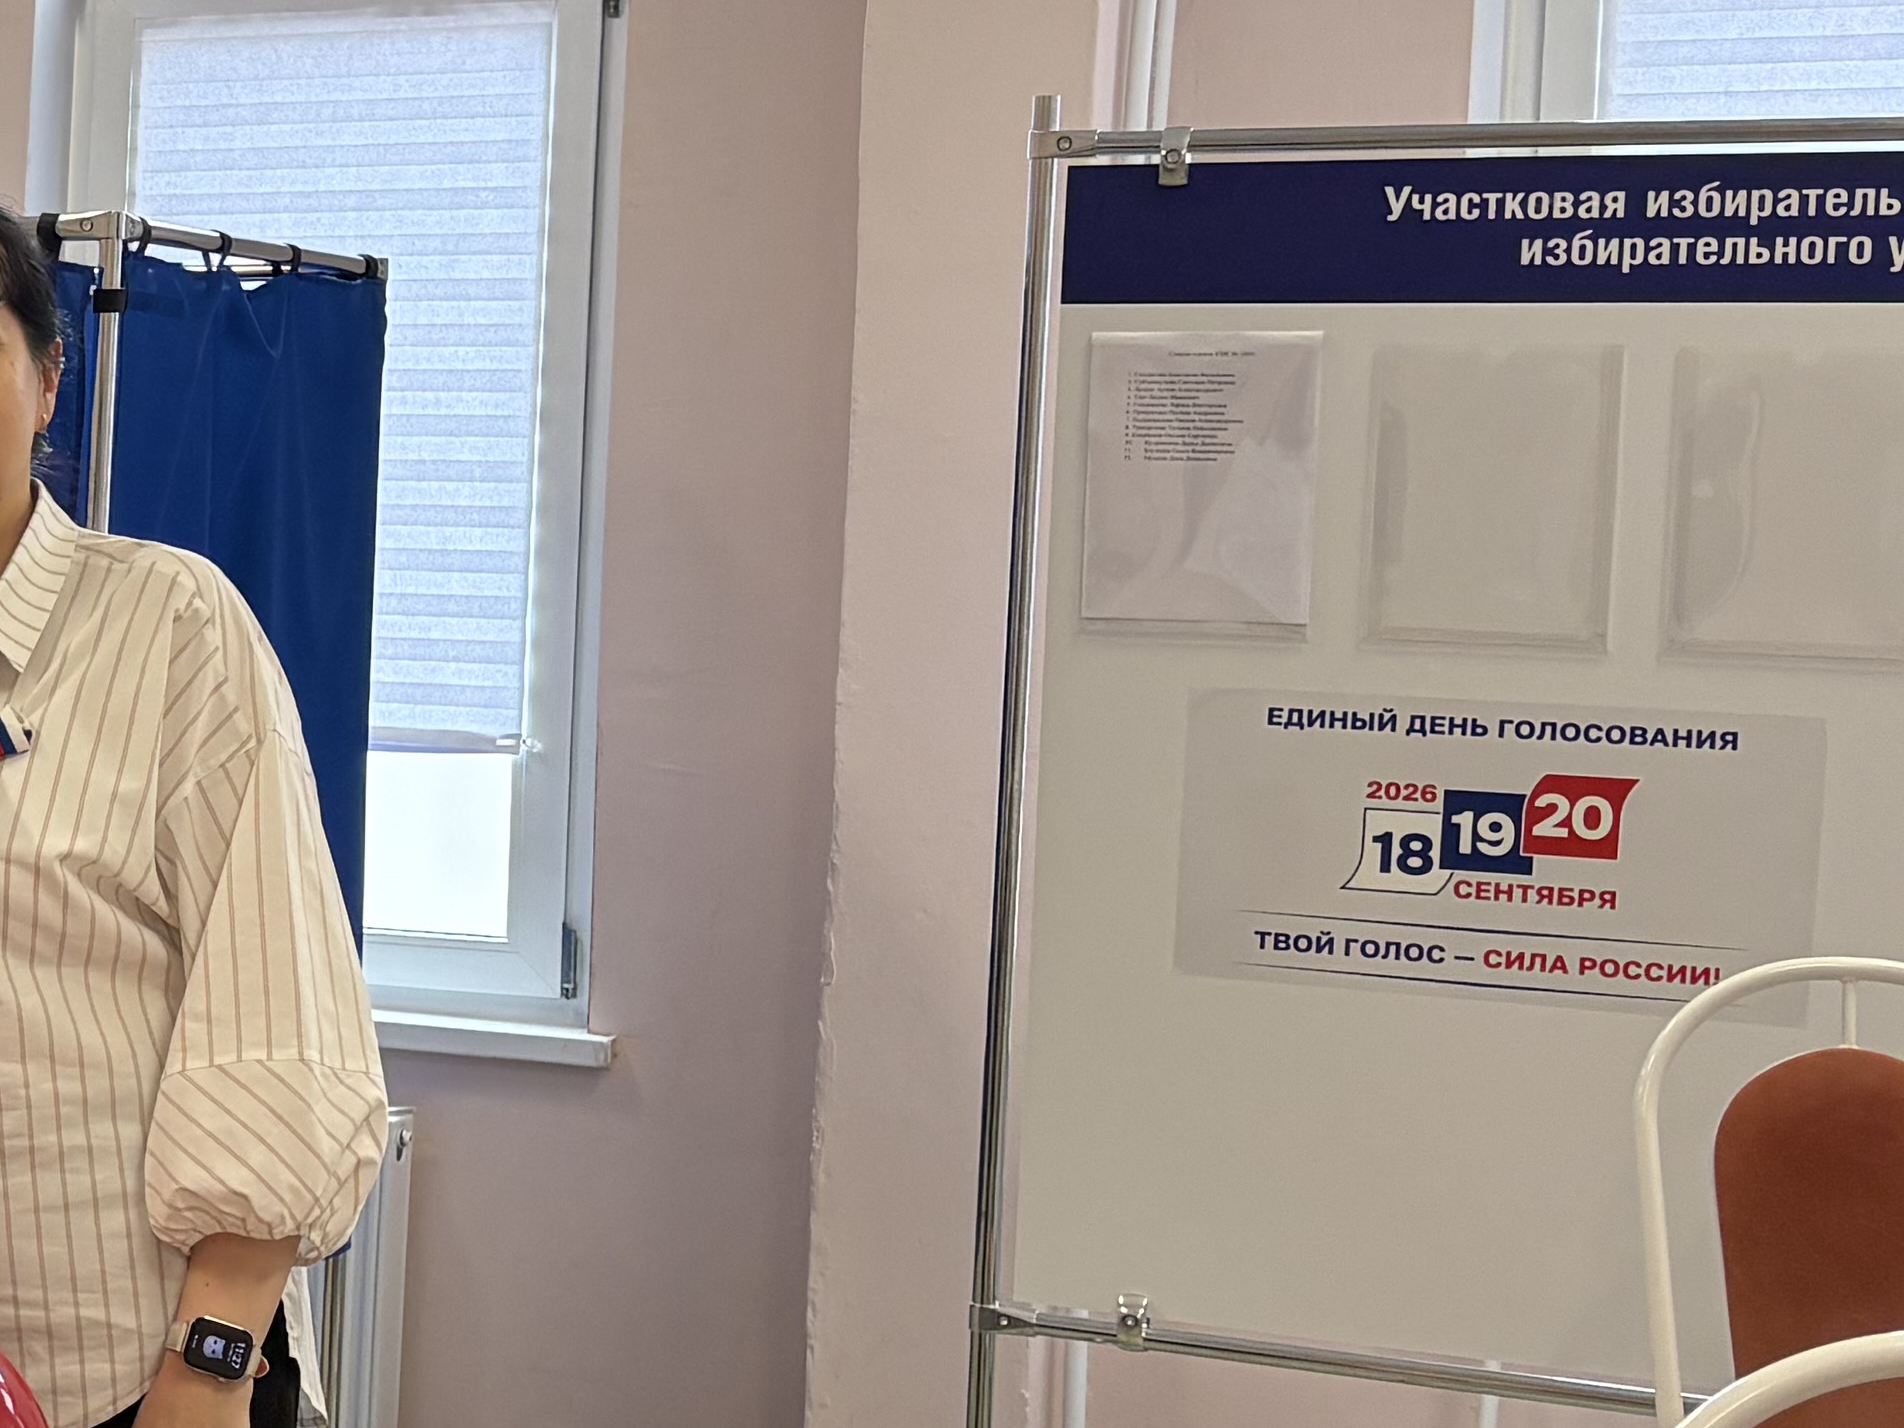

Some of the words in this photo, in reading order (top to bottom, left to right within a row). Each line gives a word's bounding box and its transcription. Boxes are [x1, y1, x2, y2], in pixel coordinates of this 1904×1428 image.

[1384, 185, 1626, 221] Участковая
[1520, 230, 1872, 273] избирательного
[1266, 707, 1398, 733] ЕДИНЫЙ
[1405, 714, 1489, 738] ДЕНЬ
[1497, 719, 1739, 752] ГОЛОСОВАНИЯ
[1365, 781, 1438, 804] 2026
[1371, 831, 1434, 876] 18
[1450, 810, 1516, 857] 19
[1531, 793, 1614, 841] 20
[1452, 879, 1618, 911] СЕНТЯБРЯ
[1253, 930, 1335, 956] ТВОЙ
[1344, 938, 1447, 964] ГОЛОС
[1482, 949, 1569, 975] СИЛА
[1578, 955, 1722, 987] РОССИИ!
